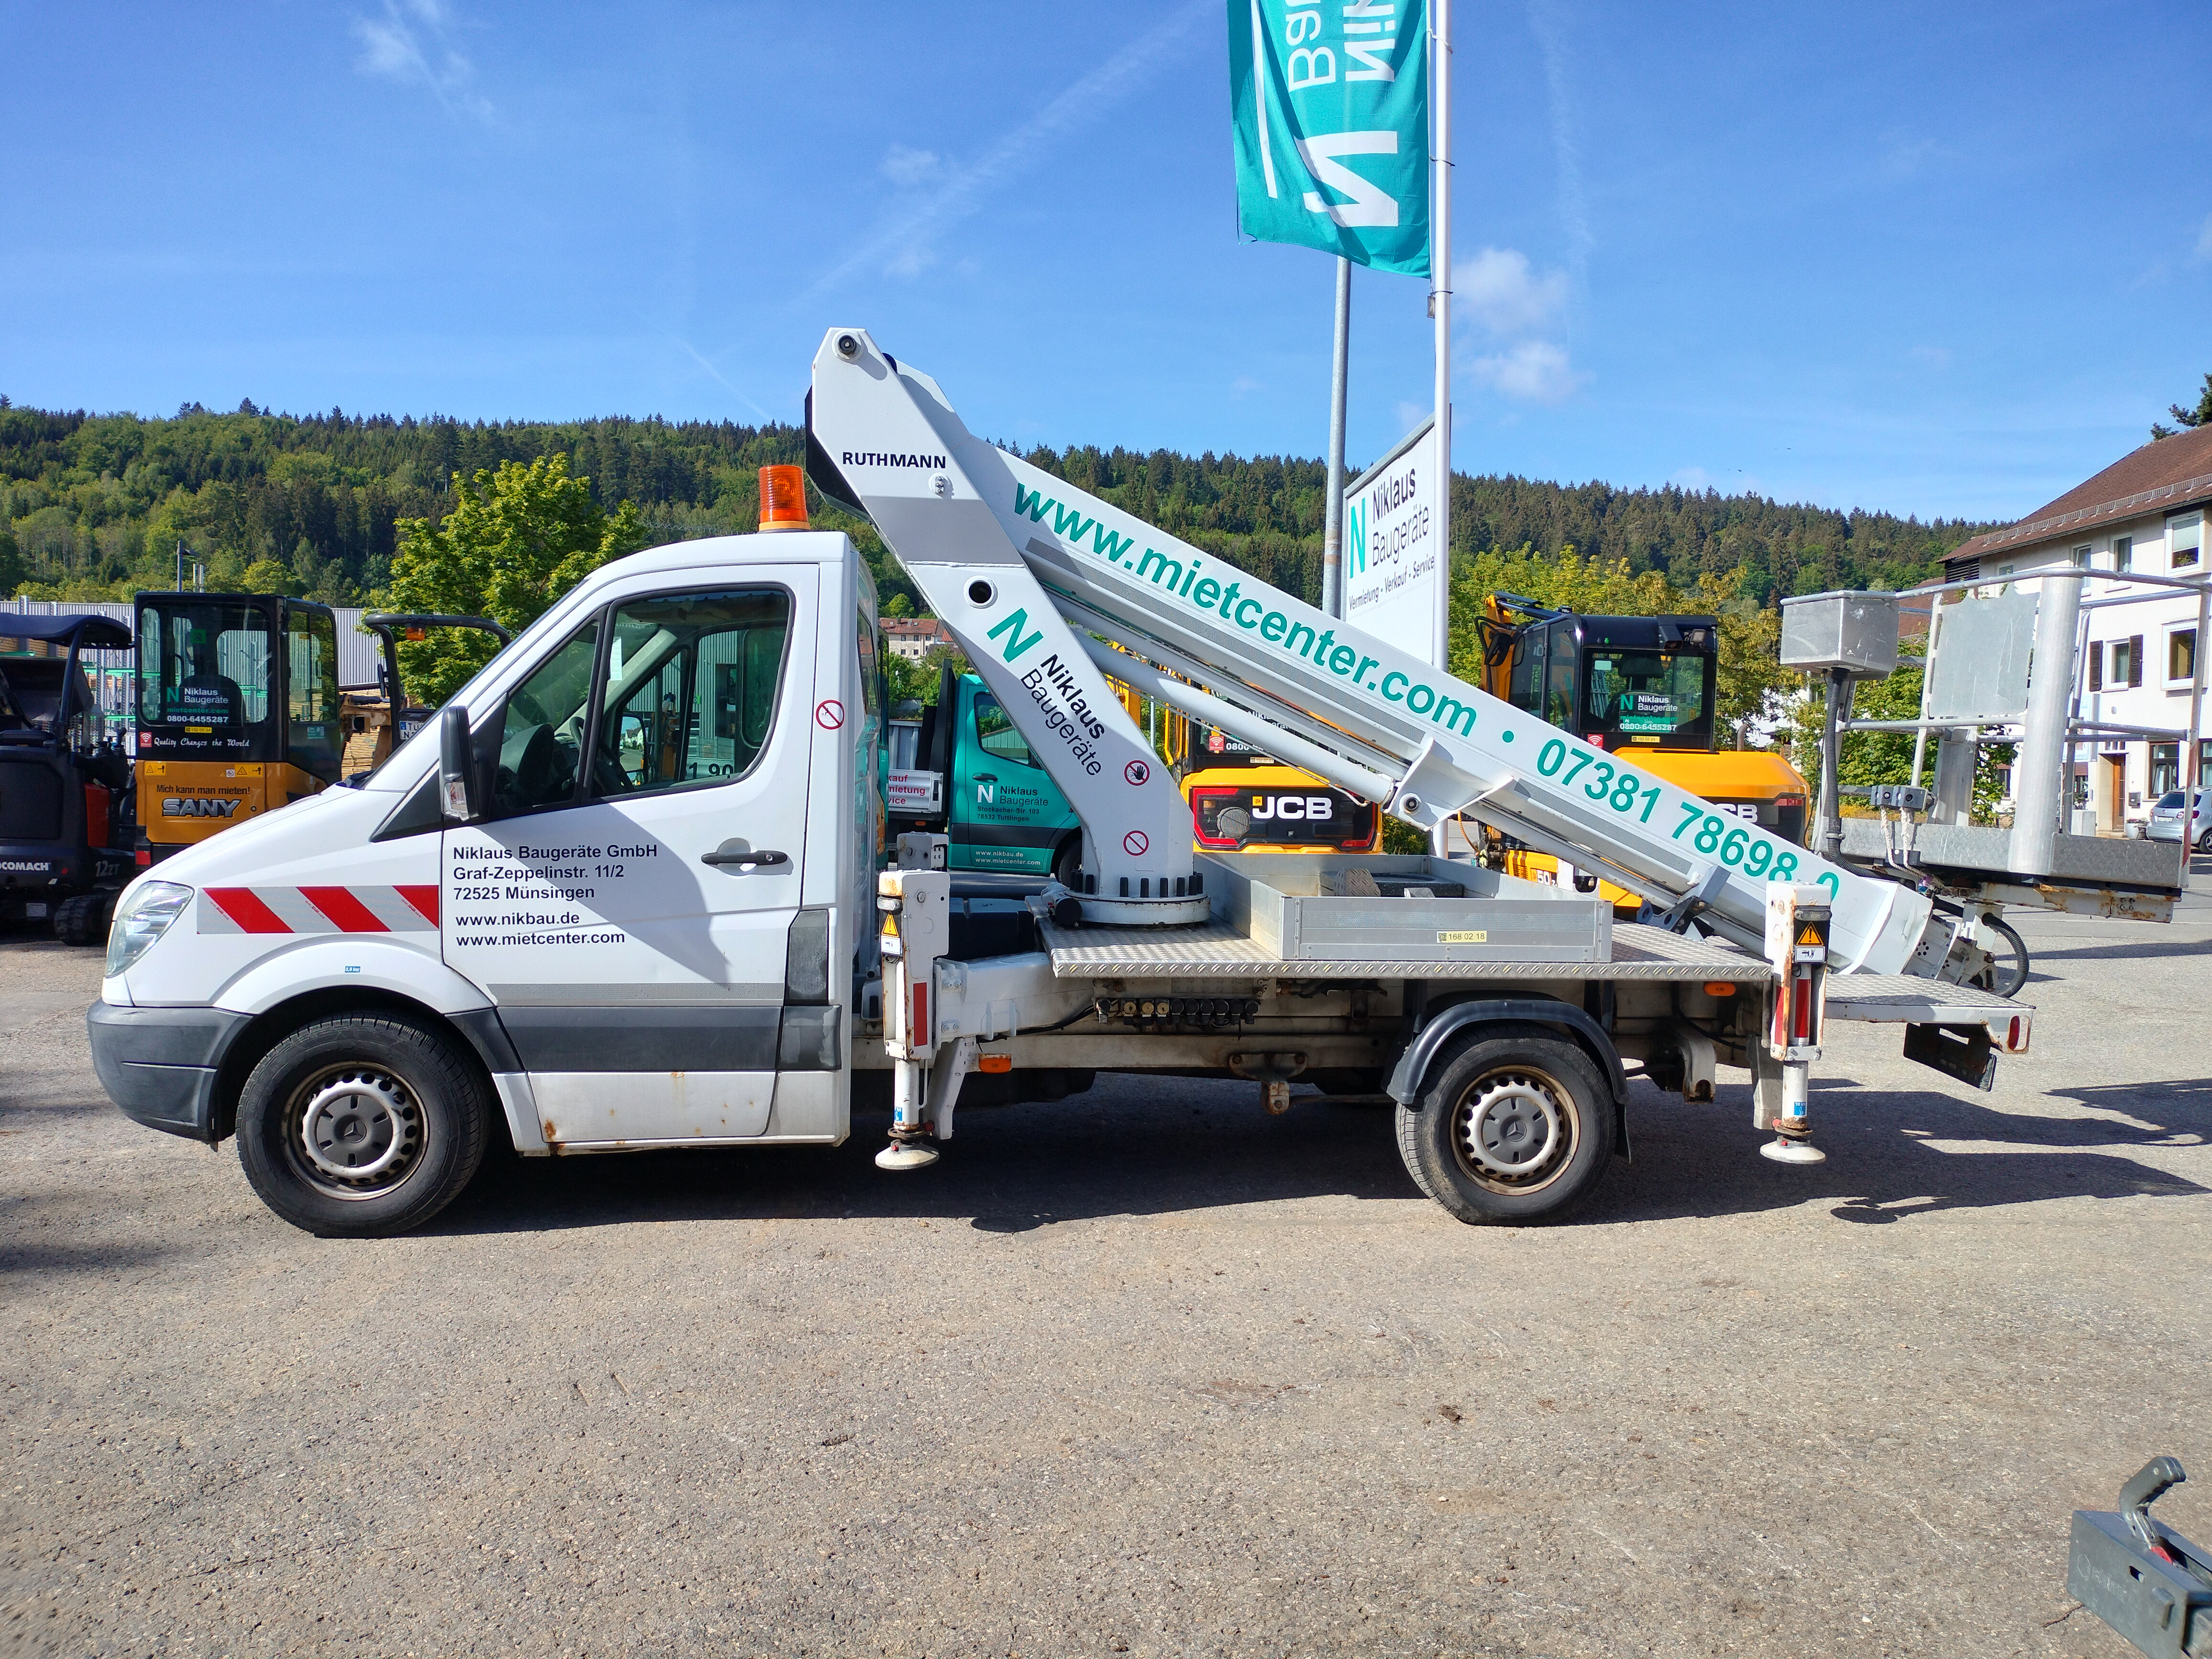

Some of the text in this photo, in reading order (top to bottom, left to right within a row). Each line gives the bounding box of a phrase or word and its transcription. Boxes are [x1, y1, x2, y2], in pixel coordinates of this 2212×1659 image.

[843, 452, 946, 469] RUTHMANN
[1372, 468, 1416, 524] Niklaus
[1349, 497, 1366, 579] N
[1372, 503, 1429, 567] Baugeräte
[1349, 586, 1379, 611] Vermietung
[1384, 565, 1408, 593] Verkauf
[1413, 553, 1435, 579] Service
[1014, 482, 1477, 738] www.mietcenter.com
[986, 607, 1044, 663] N
[167, 687, 179, 702] N
[184, 696, 228, 704] Baugeräte
[1040, 653, 1105, 739] Niklaus
[1621, 695, 1633, 710] N
[1638, 704, 1678, 713] Baugeräte
[1020, 668, 1101, 776] Baugeräte
[154, 737, 176, 748] Quality
[180, 738, 207, 748] Changes
[227, 739, 250, 747] World
[156, 785, 174, 793] Mich
[1537, 739, 1661, 823] 07381
[977, 785, 993, 803] N
[1000, 786, 1038, 796] Niklaus
[162, 798, 242, 818] SANY
[1000, 796, 1049, 807] Baugeräte
[1252, 796, 1332, 819] JCB
[453, 844, 657, 862] Niklaus Baugeräte GmbH
[0, 862, 49, 871] COMACH
[453, 864, 624, 882] Graf-Zeppelinstr. 11/2
[1537, 869, 1550, 886] 50
[454, 886, 595, 902] 72525 Münsingen
[455, 911, 580, 926] www.nikbau.de
[456, 932, 625, 946] www.mietcenter.com
